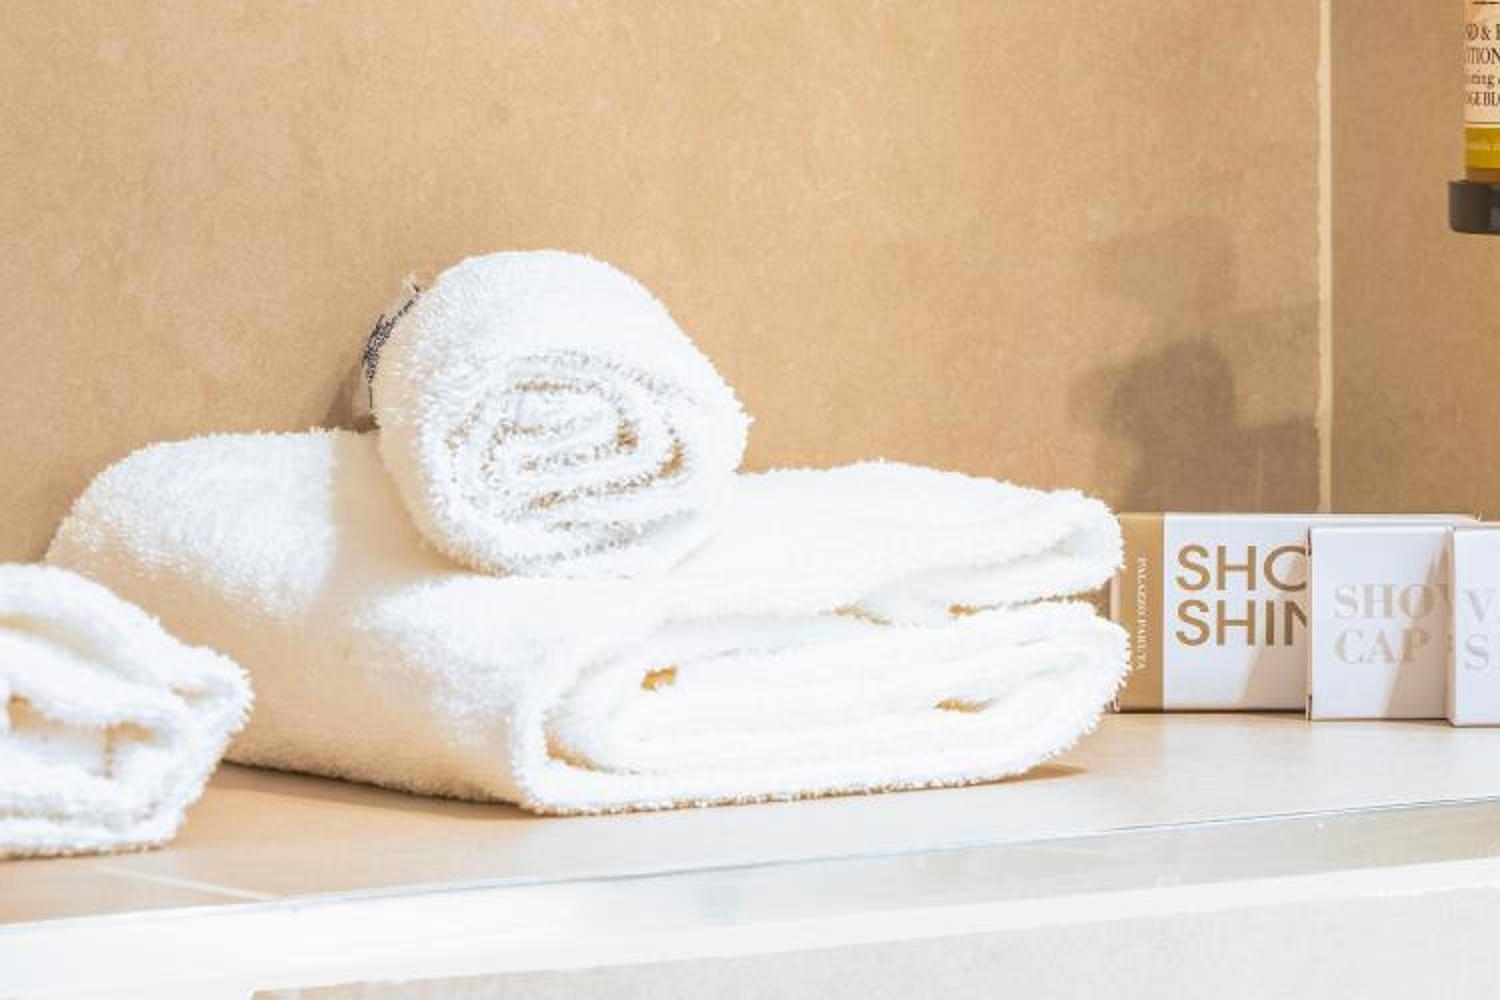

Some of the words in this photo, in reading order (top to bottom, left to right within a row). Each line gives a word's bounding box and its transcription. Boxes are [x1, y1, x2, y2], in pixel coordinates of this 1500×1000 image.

[1175, 544, 1307, 593] SHO
[1334, 582, 1456, 620] SHO
[1334, 628, 1430, 665] CAP
